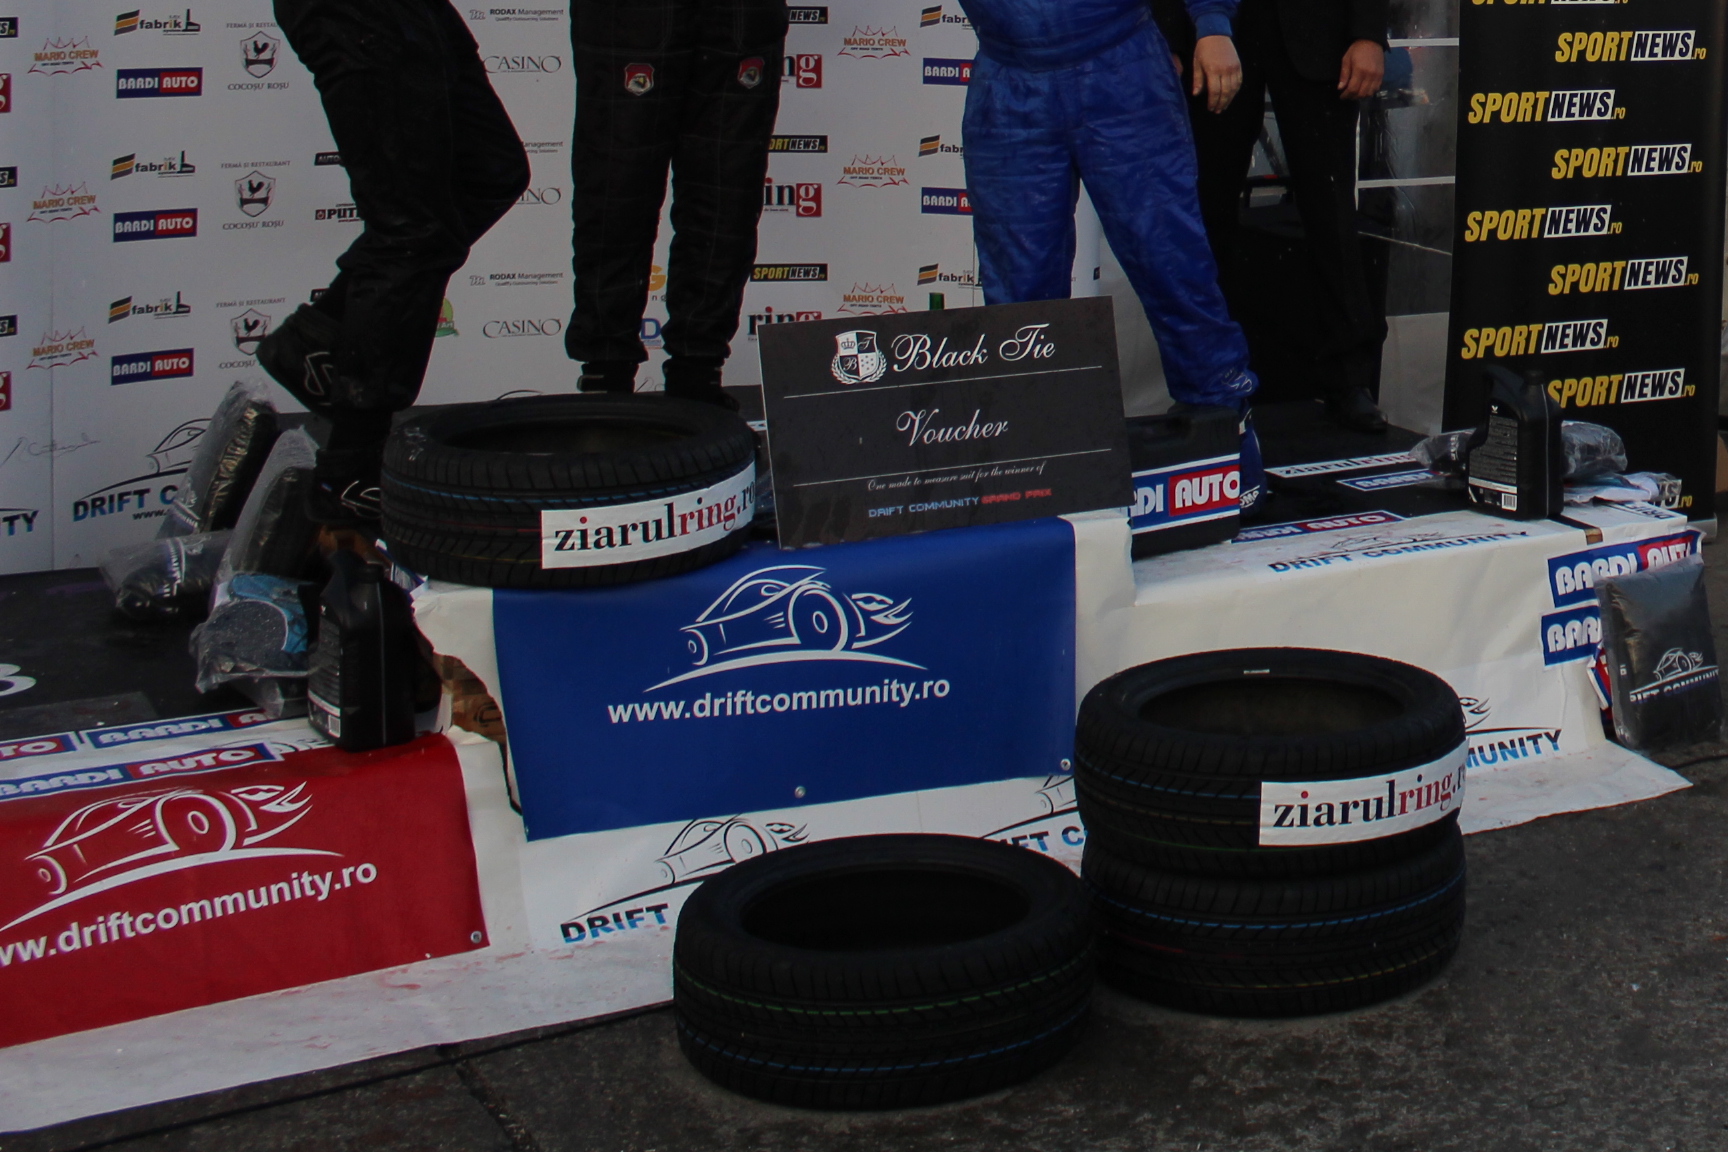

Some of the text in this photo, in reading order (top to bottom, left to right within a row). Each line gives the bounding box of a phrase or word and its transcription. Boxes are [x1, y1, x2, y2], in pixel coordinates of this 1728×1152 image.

[139, 19, 182, 31] fabrik
[844, 38, 907, 47] MARIO CREW
[1555, 30, 1706, 62] SPORTNEWS.ro
[34, 50, 99, 61] MARIO CREW
[483, 55, 561, 73] CASINO
[924, 66, 959, 77] BARDI
[118, 76, 198, 90] BARDI AUTO
[1468, 89, 1626, 123] SPORTNEWS.ro
[135, 159, 177, 173] fabrik
[843, 167, 905, 176] MARIO CREW
[1551, 143, 1702, 179] SPORTNEWS.ro
[33, 195, 96, 209] MARIO CREW
[923, 196, 957, 206] BARDI
[115, 217, 193, 234] BARDI AUTO
[1464, 205, 1622, 242] SPORTNEWS.ro
[517, 272, 563, 280] Management
[753, 267, 825, 279] SPORTNEWS.ro
[938, 272, 975, 284] fabrik
[1548, 256, 1699, 296] SPORTNEWS.ro
[132, 301, 173, 316] fabrik
[246, 297, 286, 307] RESTAURANT
[843, 294, 904, 305] MARIO CREW
[483, 318, 561, 339] CASINO
[1461, 319, 1619, 359] SPORTNEWS.ro
[33, 339, 94, 356] MARIO CREW
[891, 323, 1056, 373] Black Tie
[113, 357, 189, 376] BARDI AUTO
[1547, 368, 1695, 409] SPORTNEWS.ro
[896, 409, 1009, 447] Voucher
[868, 460, 1047, 491] One made to measure suit for the winner of
[1175, 470, 1240, 508] AUTO
[73, 489, 150, 522] DRIFT
[869, 489, 1052, 517] DRIFT COMMUNITY GRAND PRIX
[1268, 530, 1528, 573] DRIFT COMMUNITY
[1547, 616, 1602, 652] BAR
[607, 677, 951, 724] www.driftcommunity.ro
[98, 718, 224, 744] BARDI
[138, 750, 255, 774] AUTO
[560, 903, 669, 944] DRIFT
